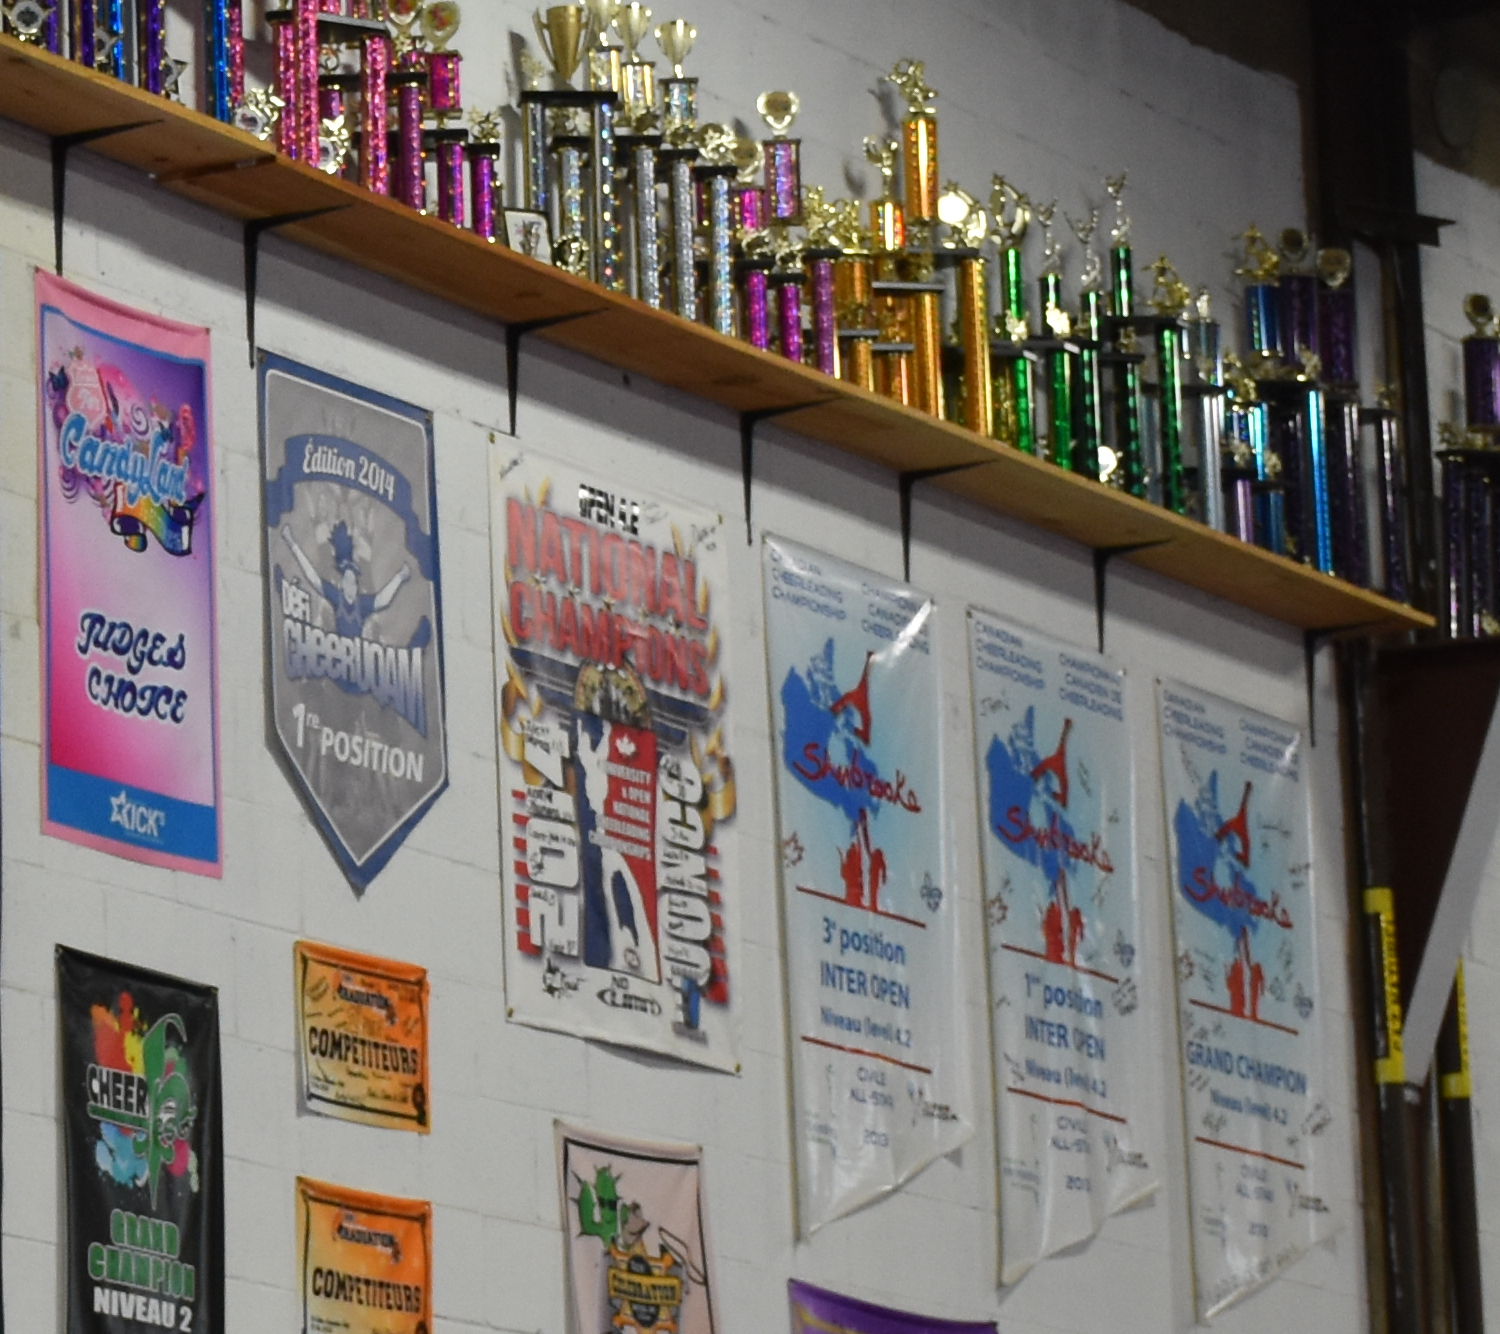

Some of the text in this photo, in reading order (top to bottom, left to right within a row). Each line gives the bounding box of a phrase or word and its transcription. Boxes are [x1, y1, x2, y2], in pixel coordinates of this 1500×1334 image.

[302, 438, 396, 501] Édition 2014
[506, 495, 708, 631] NATIONAL
[75, 611, 188, 675] JUDGES
[508, 578, 711, 696] CHAMPIONS
[86, 672, 188, 726] CHOICE
[321, 727, 424, 783] POSITION
[840, 928, 906, 965] position
[820, 960, 911, 1009] INTER OPEN
[308, 1024, 420, 1077] COMPETITEURS
[1025, 1016, 1069, 1048] INTER
[87, 1064, 149, 1117] CHEER
[1186, 1041, 1307, 1095] GRAND CHAMPION
[110, 1209, 180, 1259] GRAND
[87, 1241, 195, 1302] CHAMPION
[311, 1264, 421, 1314] COMPETITEURS
[93, 1285, 176, 1329] NIVEAU
